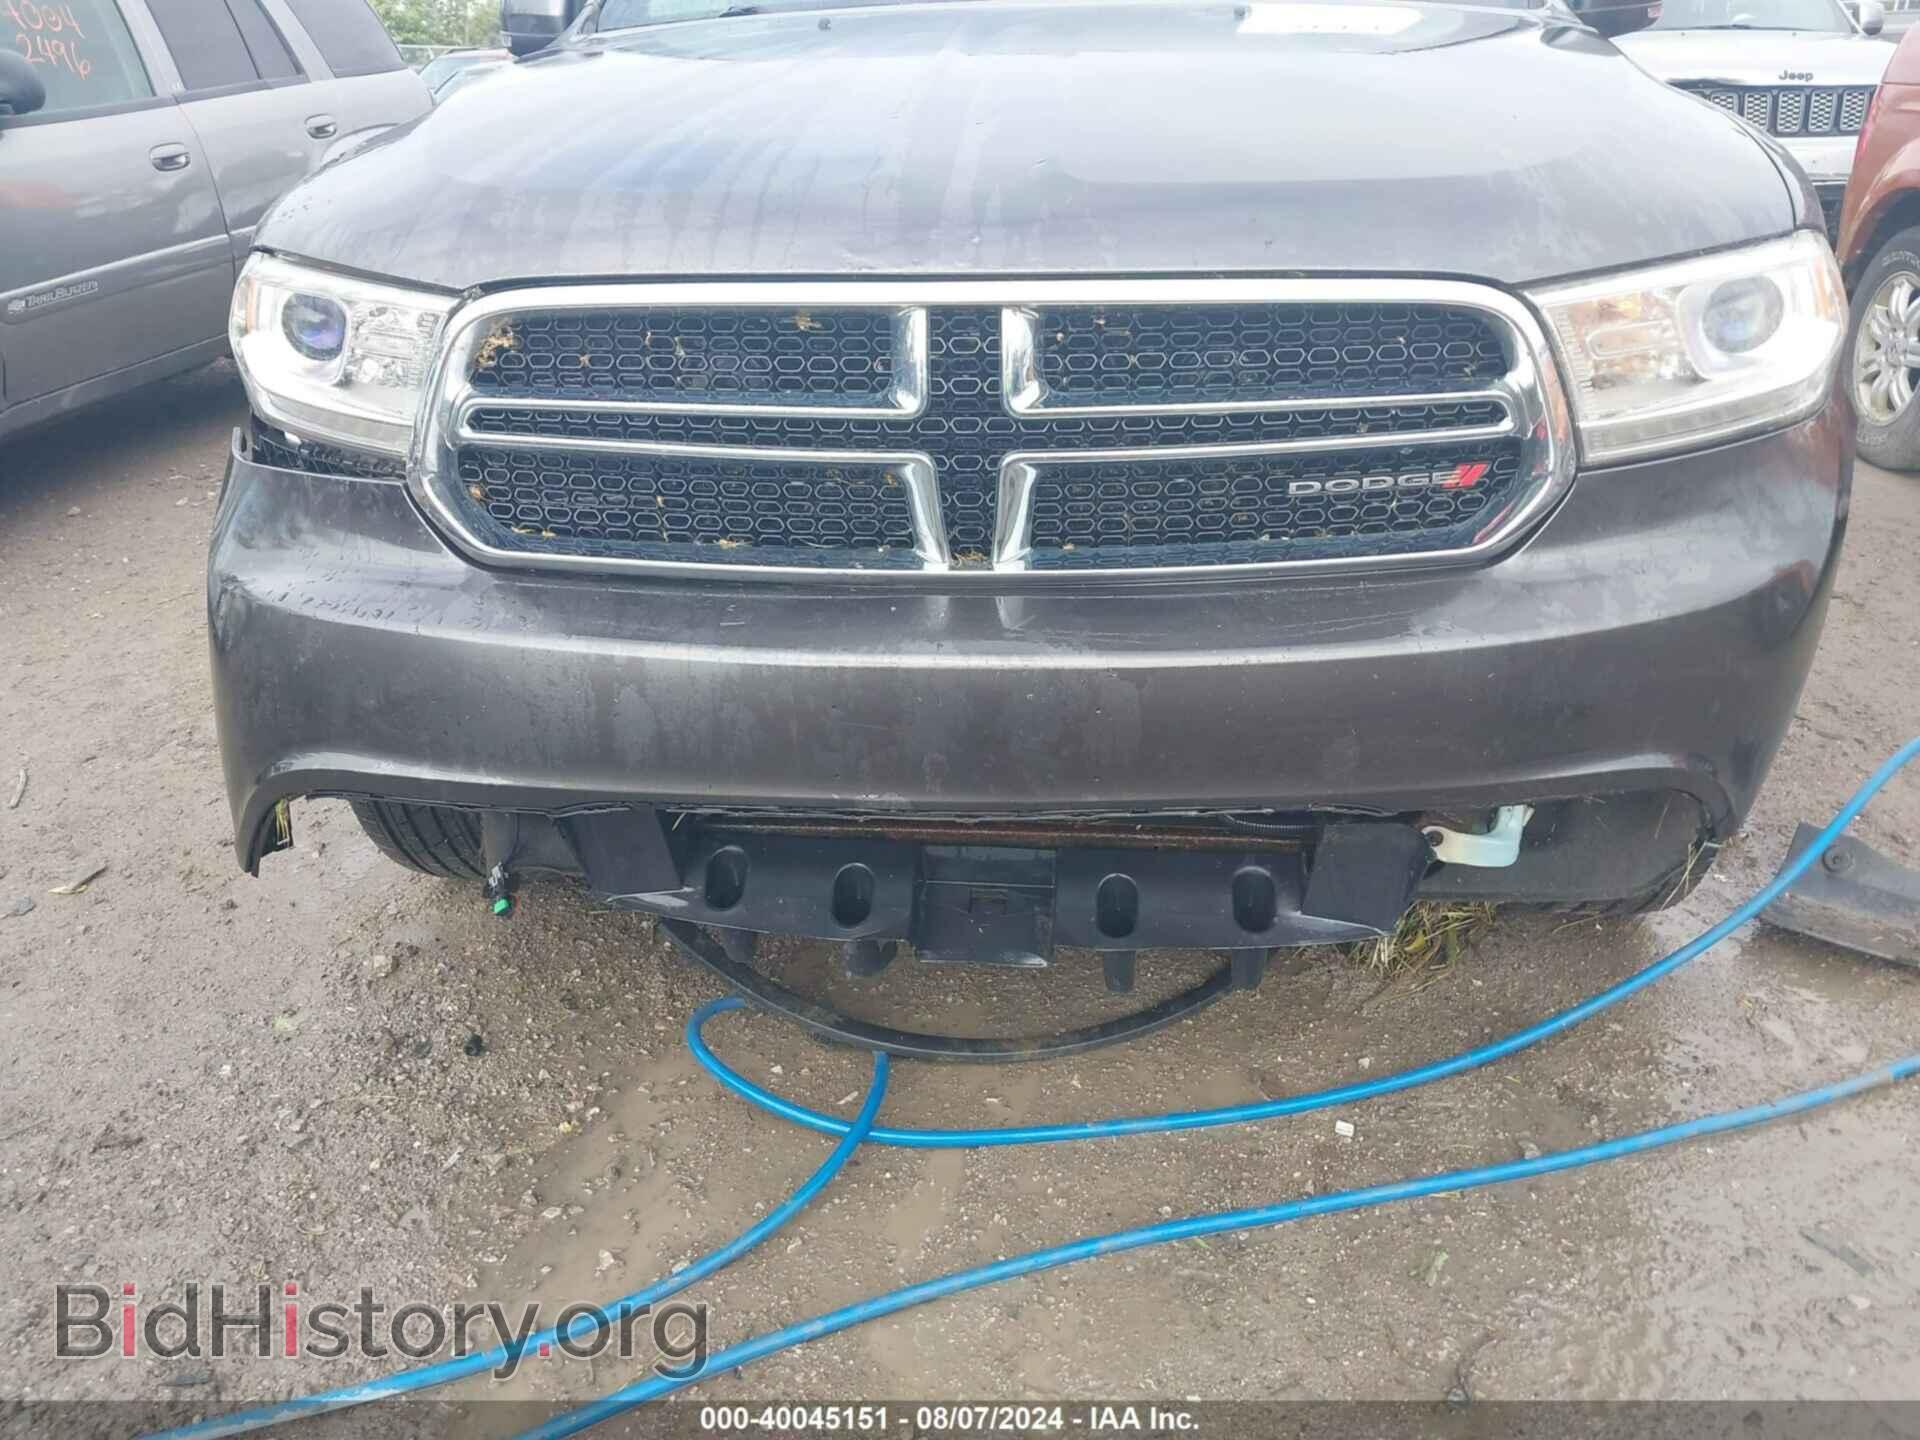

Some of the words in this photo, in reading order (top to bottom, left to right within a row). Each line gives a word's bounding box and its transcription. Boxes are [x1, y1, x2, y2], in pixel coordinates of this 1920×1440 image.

[16, 33, 91, 80] 2496
[1778, 69, 1814, 83] Jeep
[1288, 470, 1460, 495] DODGE
